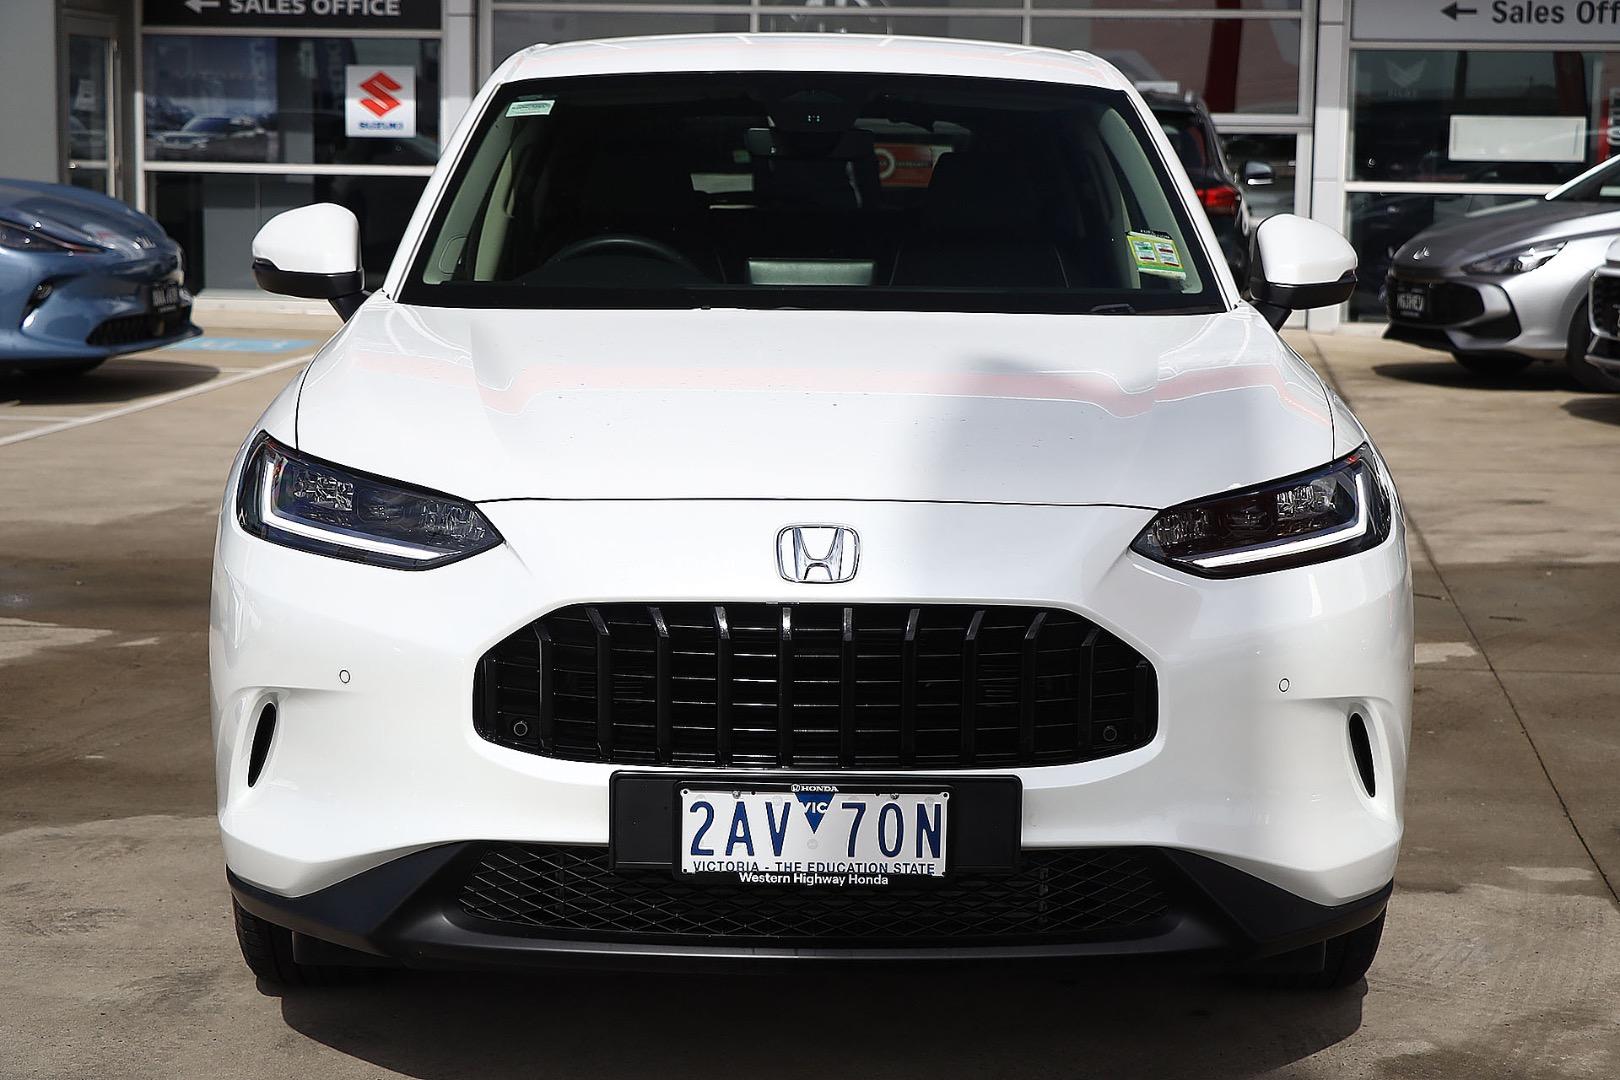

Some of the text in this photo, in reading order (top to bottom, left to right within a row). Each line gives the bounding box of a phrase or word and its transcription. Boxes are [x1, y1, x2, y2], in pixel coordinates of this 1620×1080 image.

[229, 0, 400, 16] SALES OFFICE
[1491, 0, 1565, 24] Sales
[801, 801, 828, 813] VIC
[689, 801, 792, 857] 2AV
[693, 861, 760, 872] VICTORIA
[774, 862, 802, 873] THE
[807, 862, 889, 874] EDUCATION
[893, 862, 935, 875] STATE
[738, 872, 889, 887] Western Highway Honda
